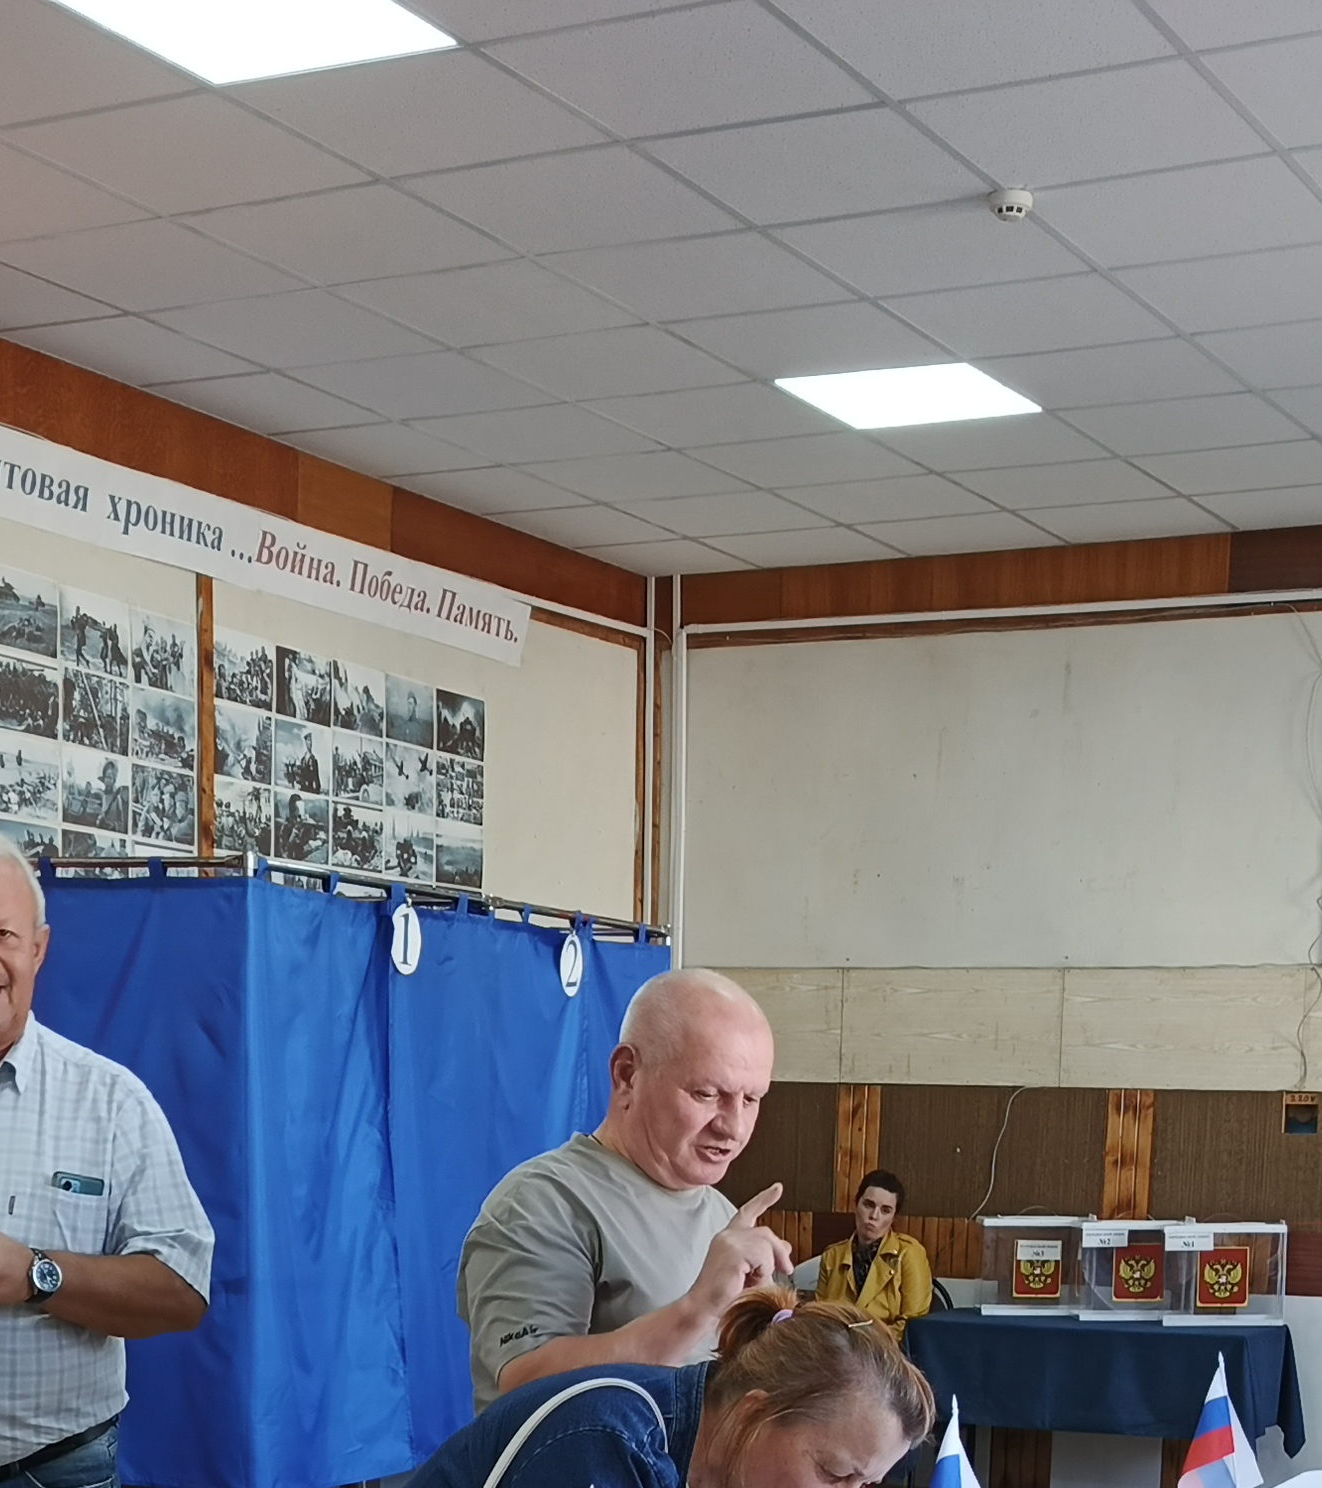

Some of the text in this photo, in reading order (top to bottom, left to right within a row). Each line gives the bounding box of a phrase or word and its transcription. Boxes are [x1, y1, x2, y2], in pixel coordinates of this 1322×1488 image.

[107, 494, 224, 551] хроника
[348, 559, 431, 614] Победа.
[436, 588, 519, 643] Память.
[399, 913, 413, 967] 1
[565, 939, 578, 988] 2
